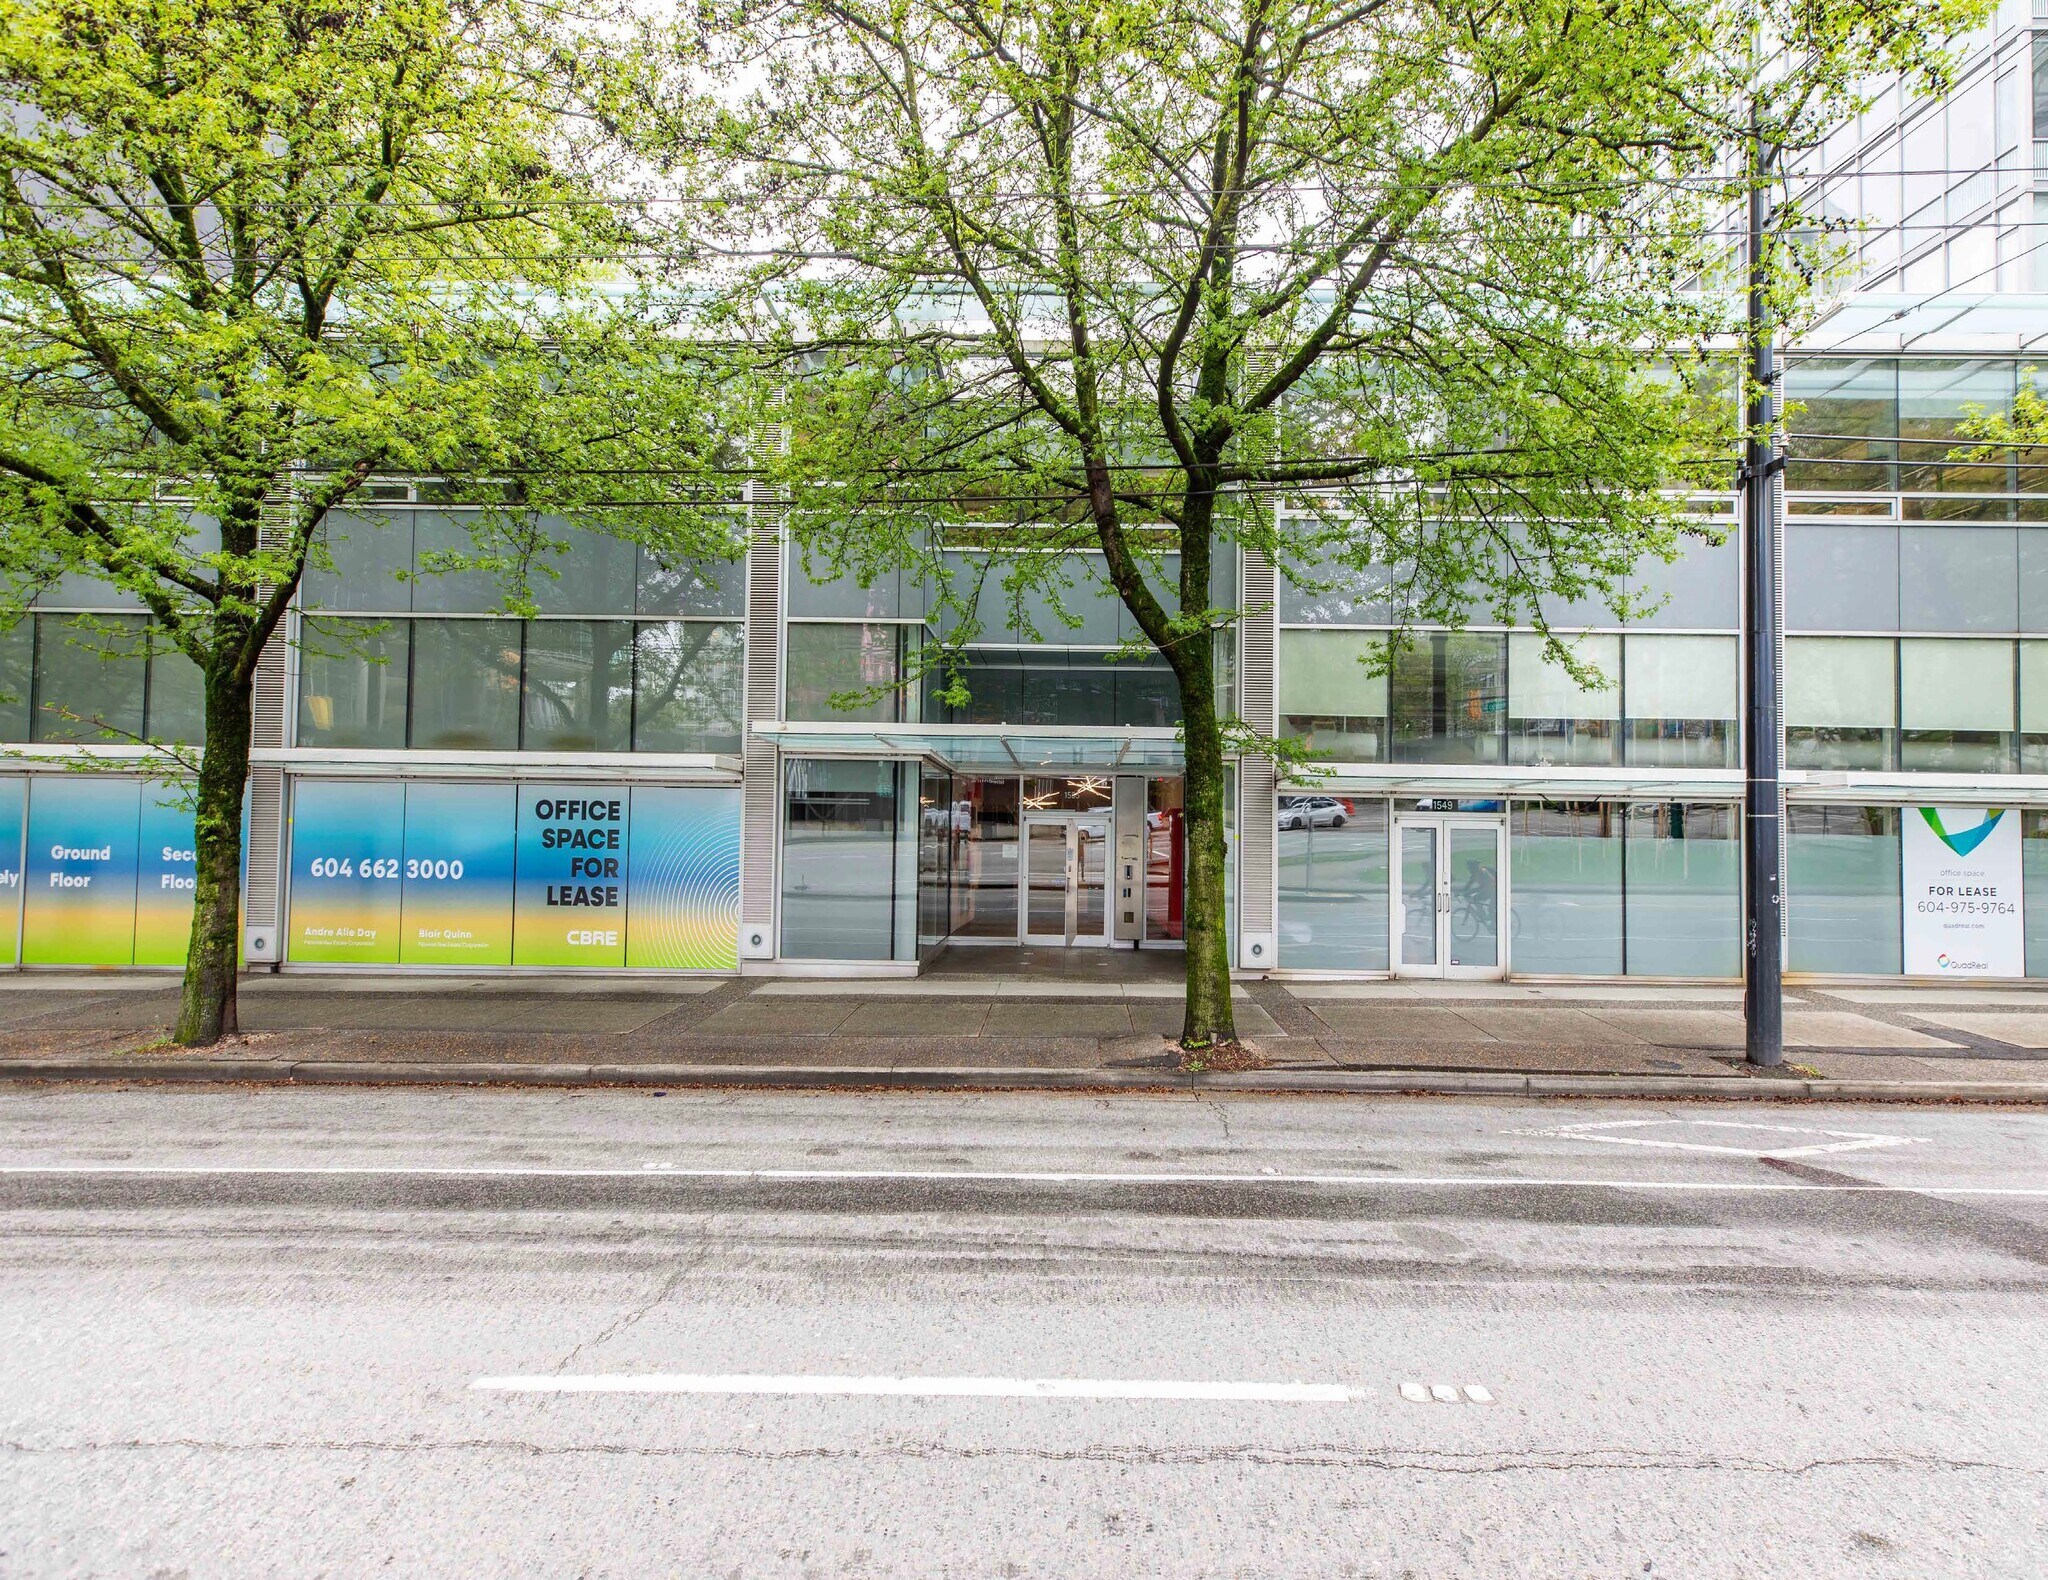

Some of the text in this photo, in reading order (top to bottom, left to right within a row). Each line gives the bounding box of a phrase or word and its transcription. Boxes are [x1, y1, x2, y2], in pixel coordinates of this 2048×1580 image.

[535, 799, 621, 821] OFFICE
[1433, 800, 1453, 810] 1549
[541, 828, 620, 850] SPACE
[51, 845, 111, 861] Ground
[310, 857, 464, 880] 604 662 3000
[571, 857, 619, 878] FOR
[1940, 869, 1961, 877] office
[50, 872, 92, 888] Floor
[161, 873, 198, 889] Floo
[546, 885, 618, 907] LEASE
[1928, 886, 1997, 897] FOR LEASE
[1917, 901, 2015, 914] 604-975-9764
[305, 927, 334, 937] Andre
[357, 928, 377, 939] Day
[419, 929, 472, 939] Blair Quinn
[566, 930, 618, 946] CBRE
[1950, 960, 1989, 970] QuadReal
